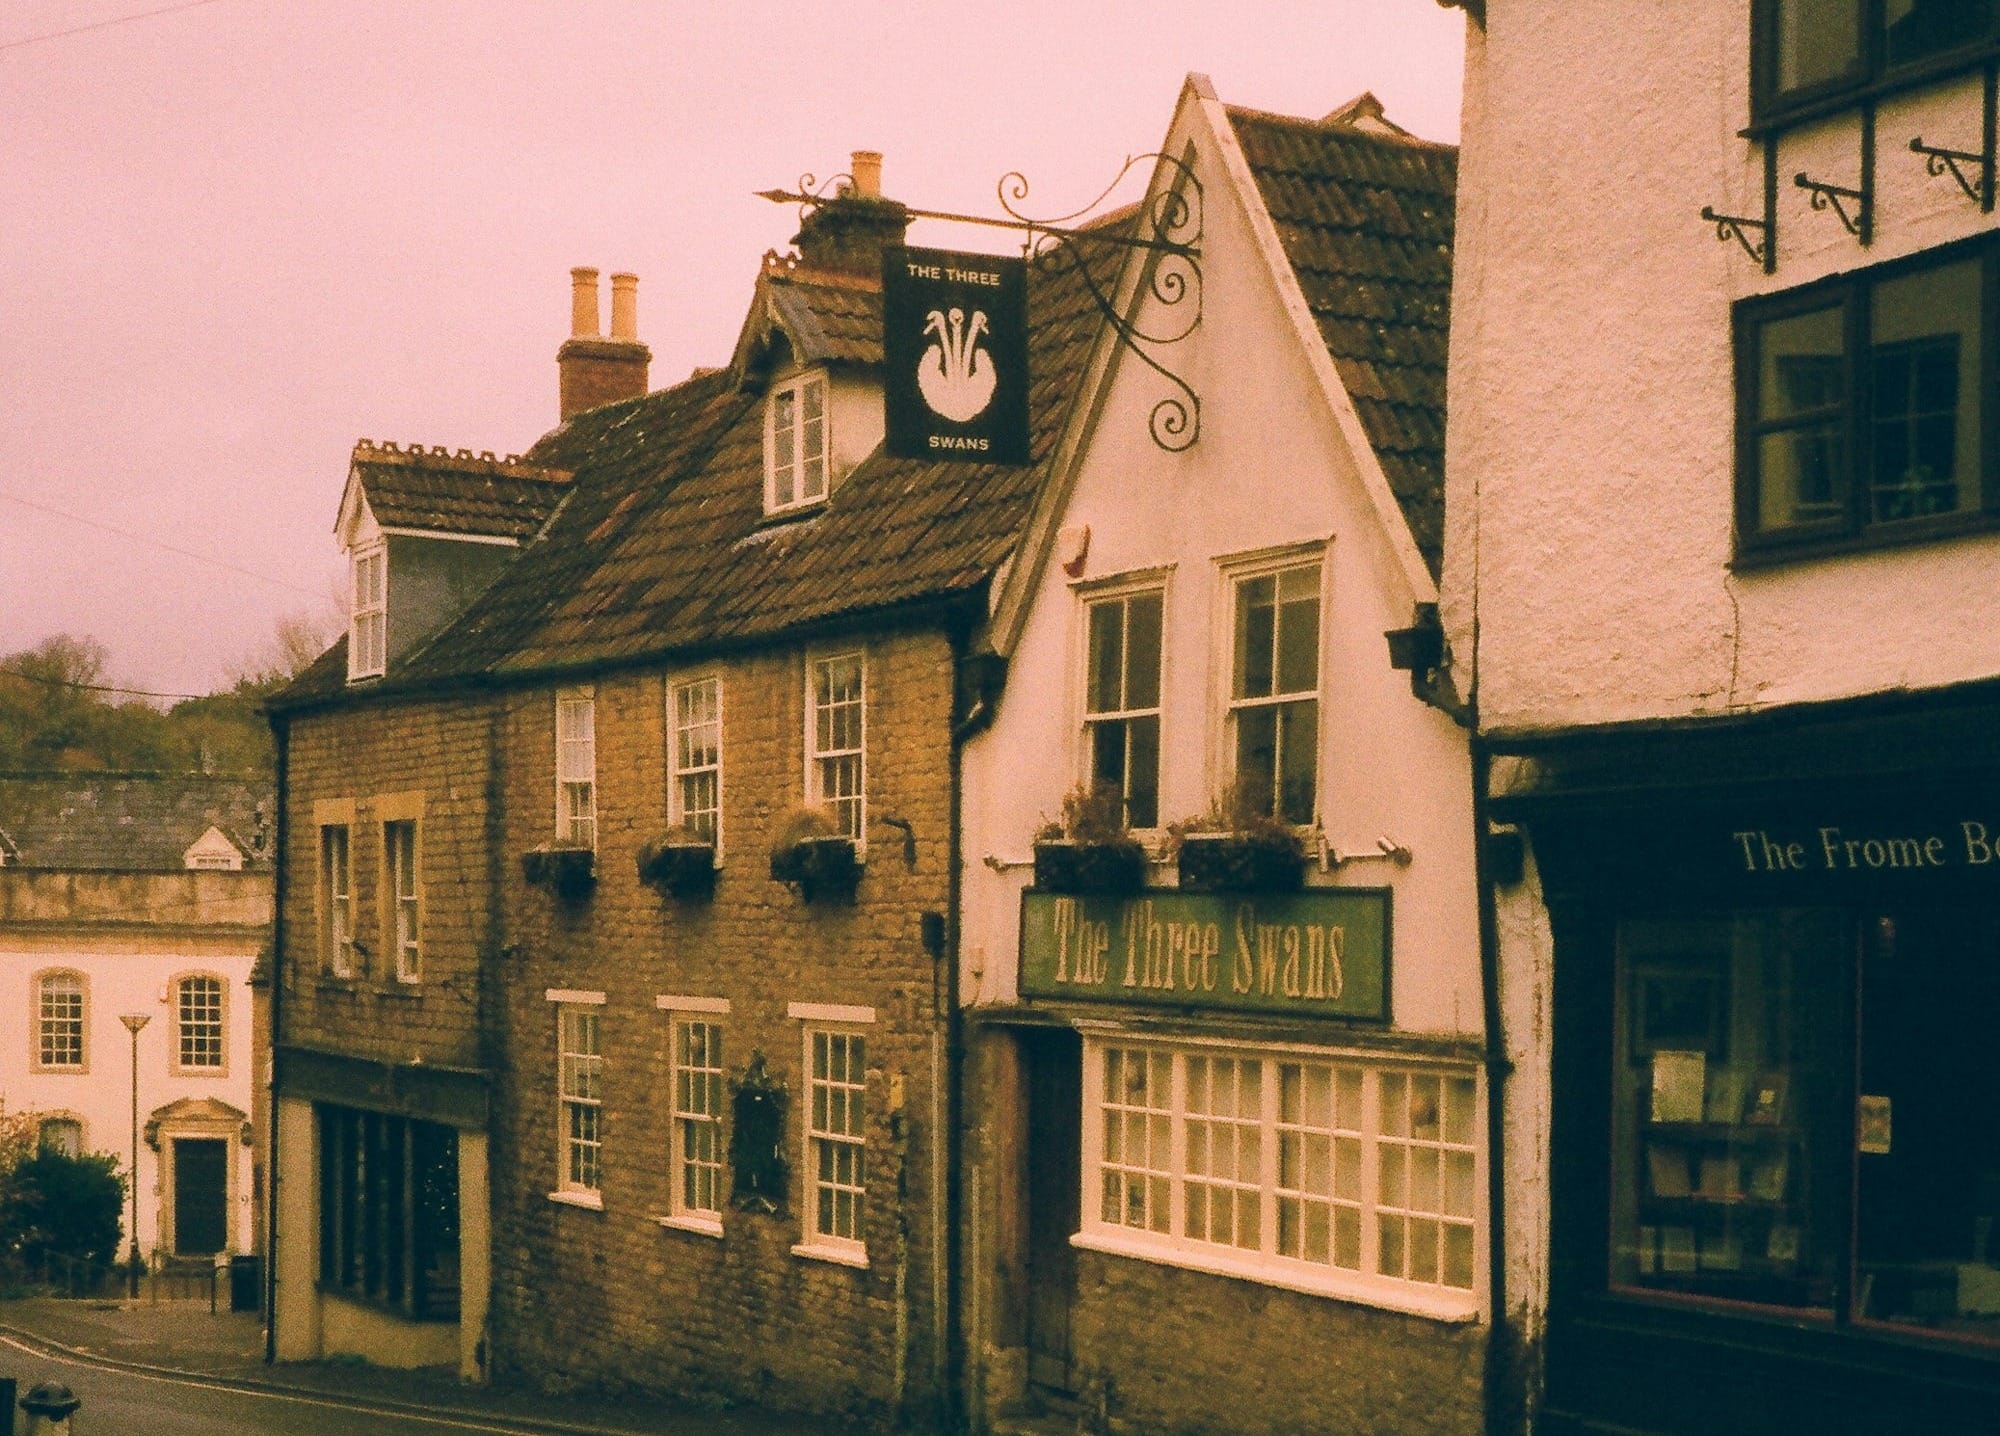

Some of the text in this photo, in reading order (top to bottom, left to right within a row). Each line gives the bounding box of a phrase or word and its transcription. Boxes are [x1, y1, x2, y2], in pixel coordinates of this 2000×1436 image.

[907, 263, 1001, 286] THE THREE
[928, 436, 990, 451] SWANS
[1733, 820, 2000, 871] The Frome B
[1054, 897, 1345, 1000] The Three Swans
